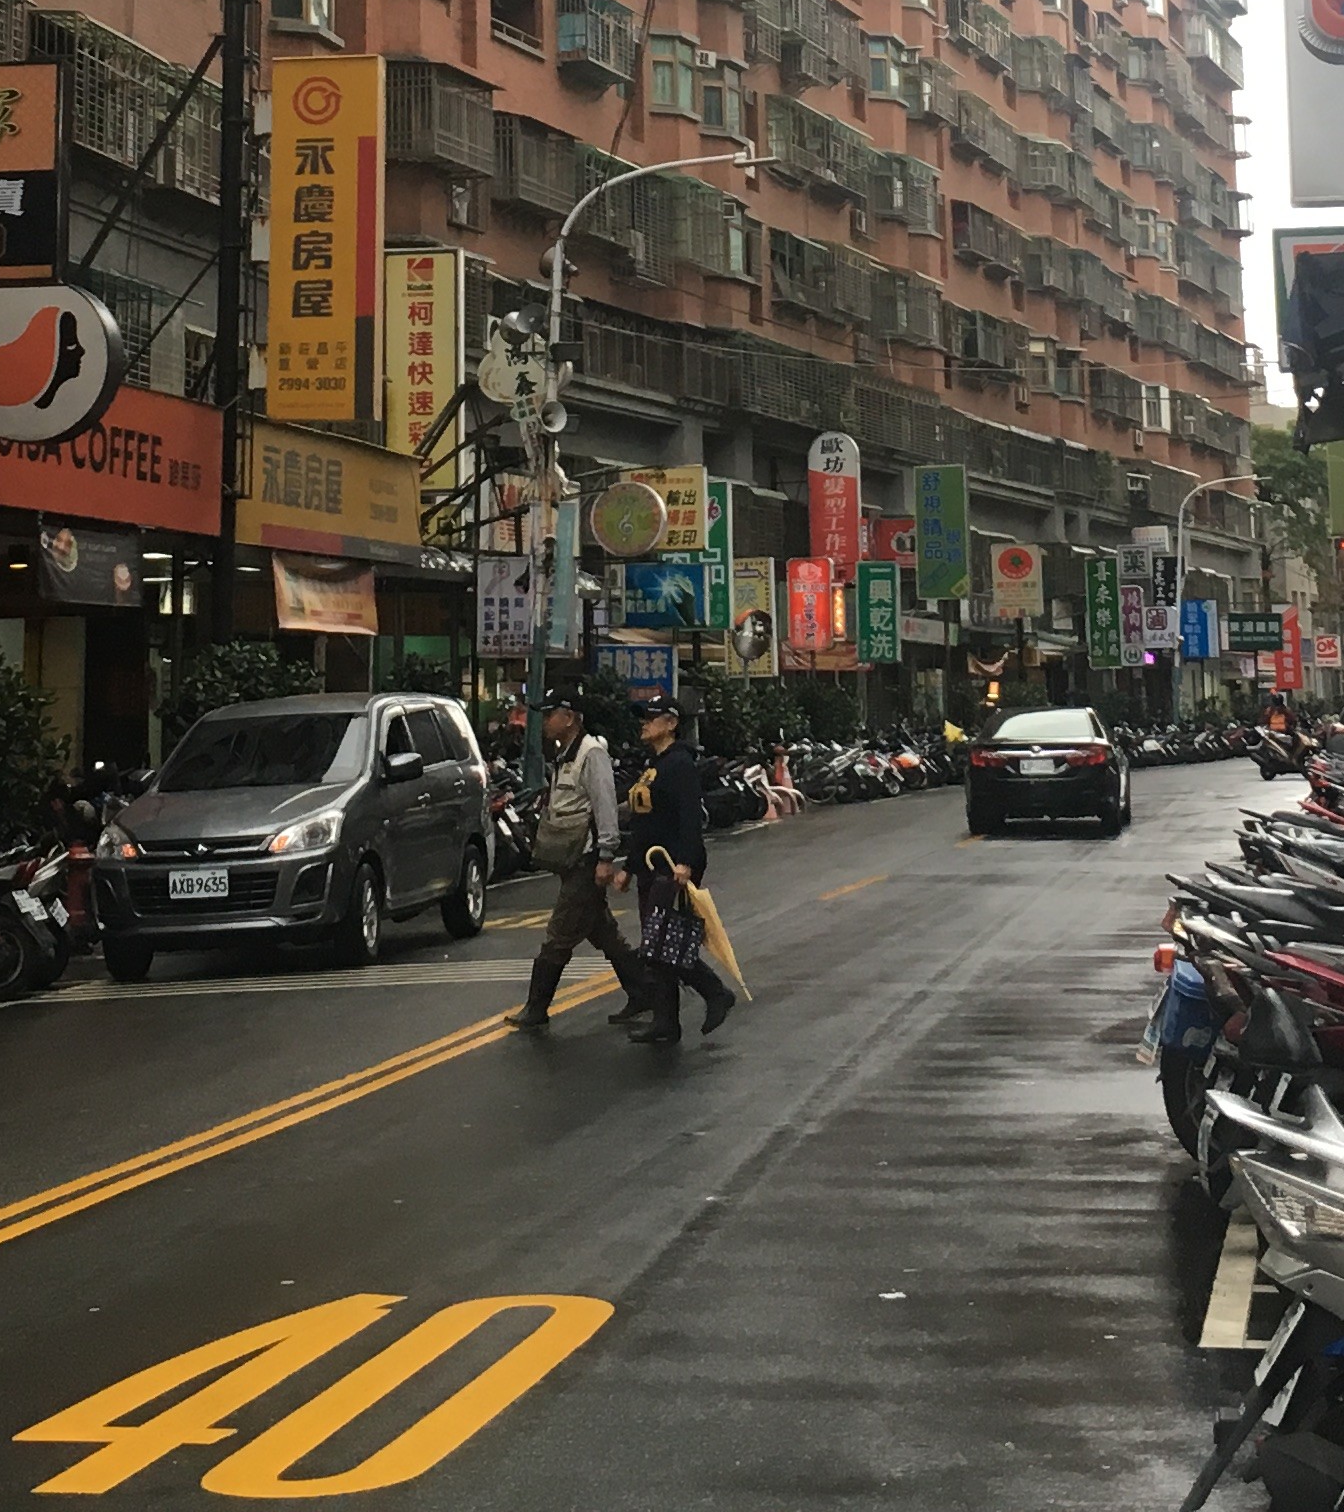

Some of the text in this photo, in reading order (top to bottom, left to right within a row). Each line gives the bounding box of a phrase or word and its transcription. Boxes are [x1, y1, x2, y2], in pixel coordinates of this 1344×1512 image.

[291, 137, 336, 319] 永慶房屋
[407, 301, 435, 475] 柯達快速彩
[68, 422, 164, 485] COFFEE
[261, 443, 344, 516] 永慶房屋
[1316, 638, 1339, 653] OK
[10, 1292, 616, 1499] 40
